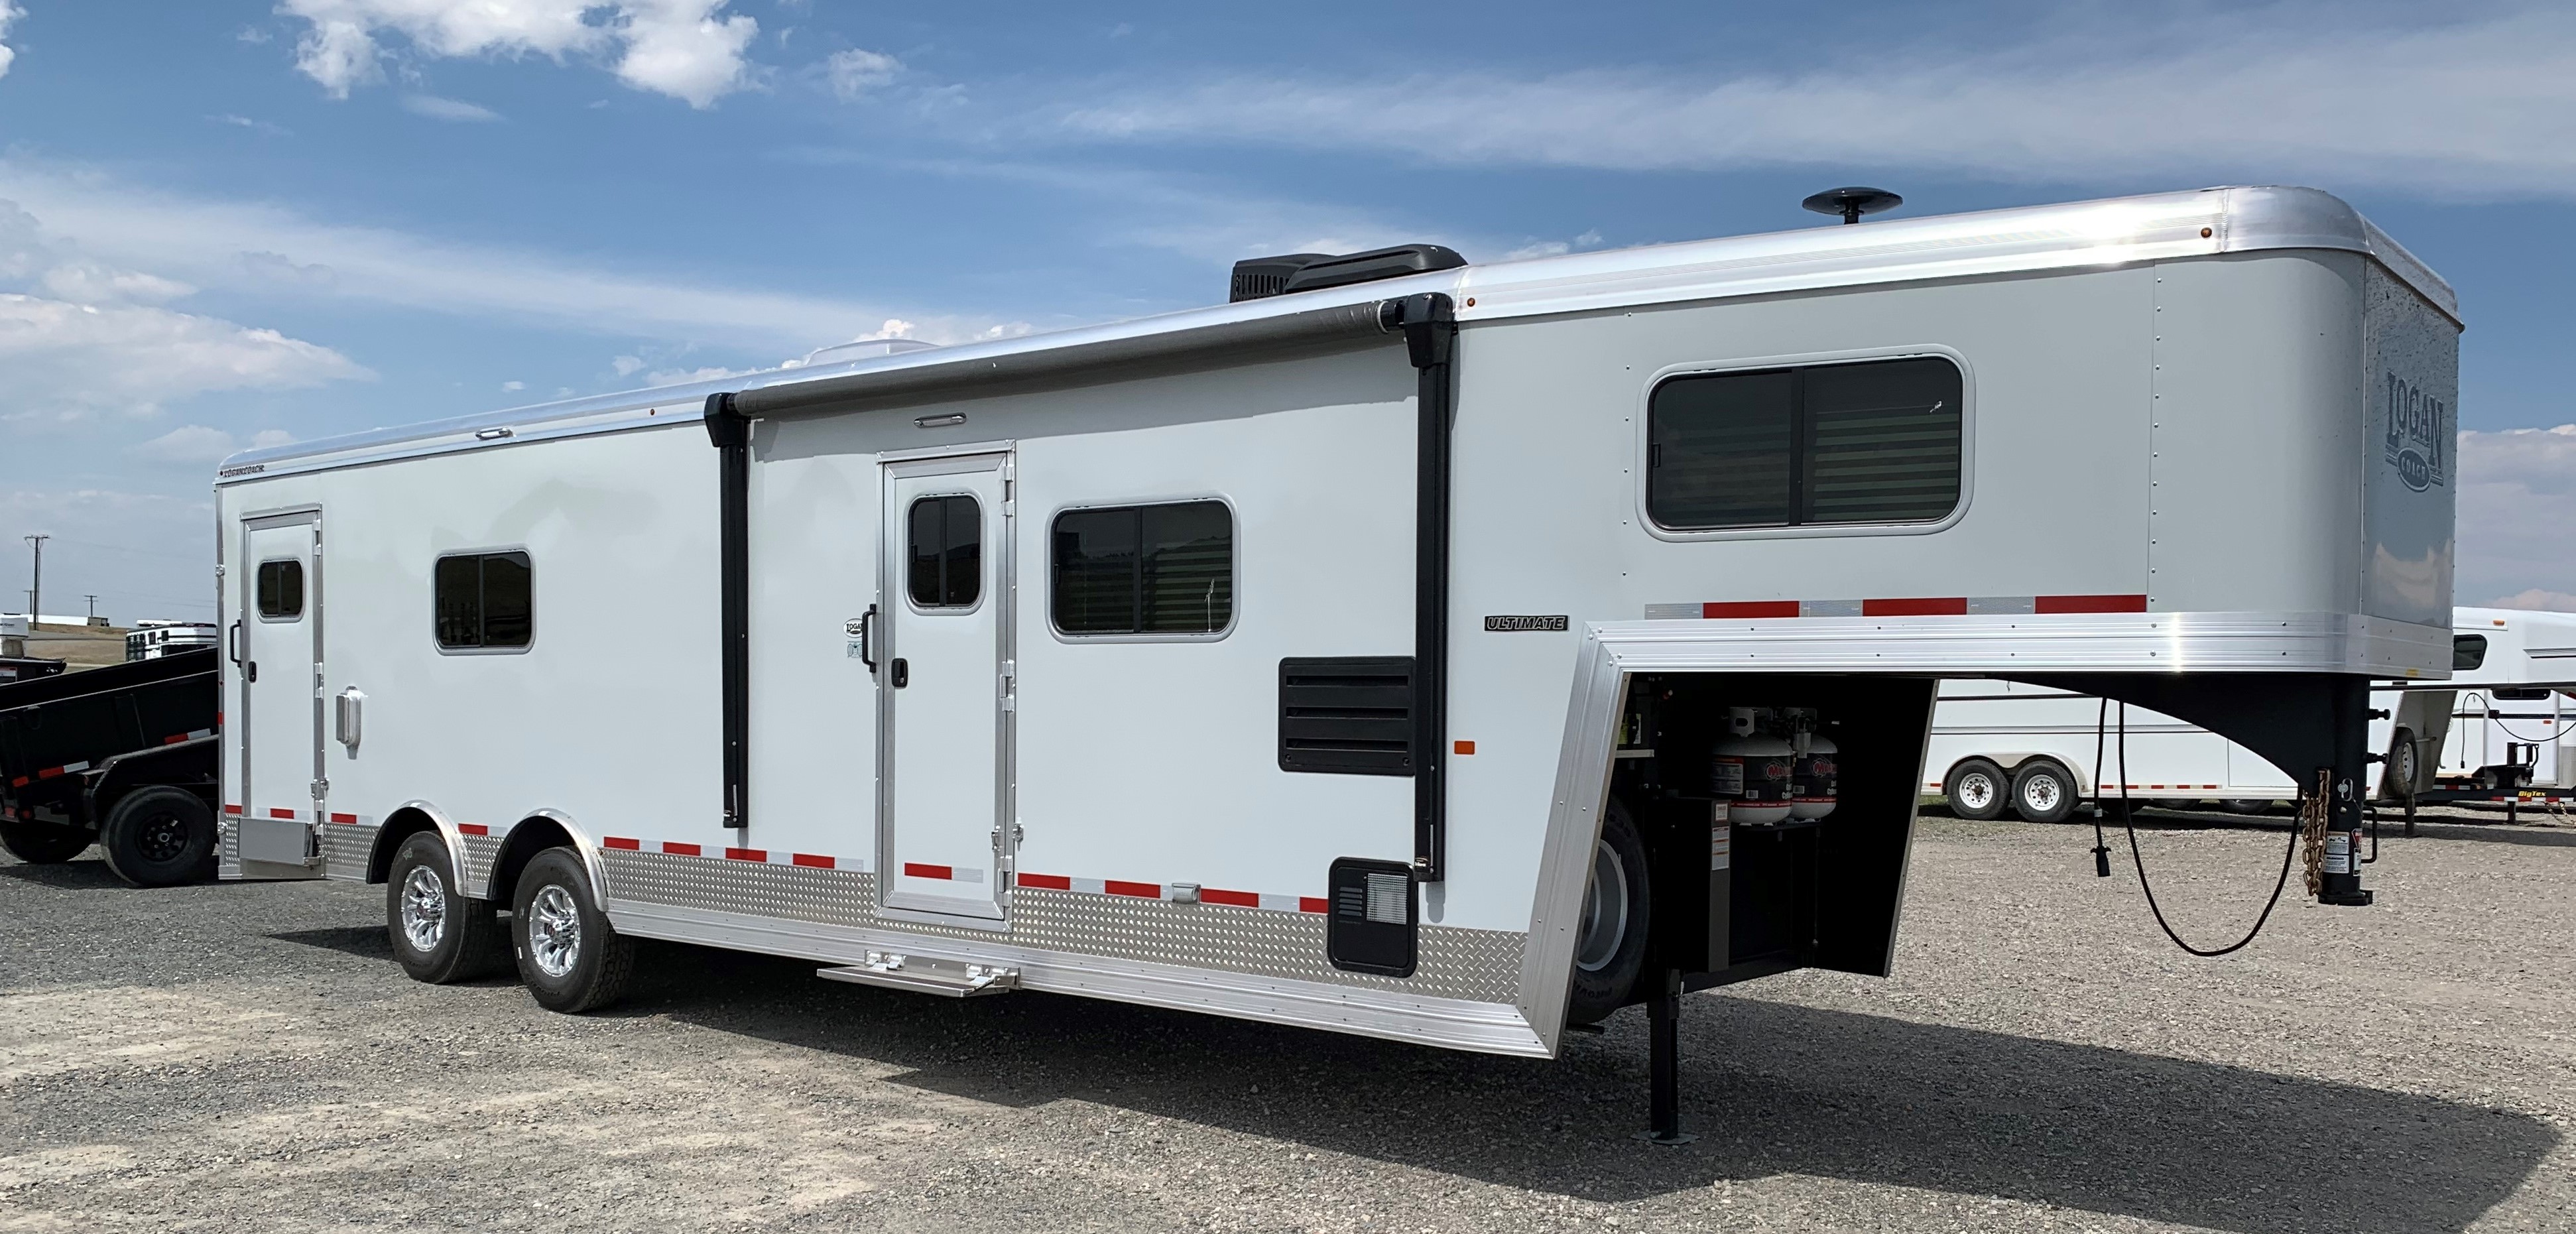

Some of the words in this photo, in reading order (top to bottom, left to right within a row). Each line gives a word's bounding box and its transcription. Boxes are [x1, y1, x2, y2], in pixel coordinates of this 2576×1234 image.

[2387, 369, 2443, 469] LOGAN
[2401, 456, 2425, 480] COACH
[1487, 616, 1565, 630] ULTIMATE
